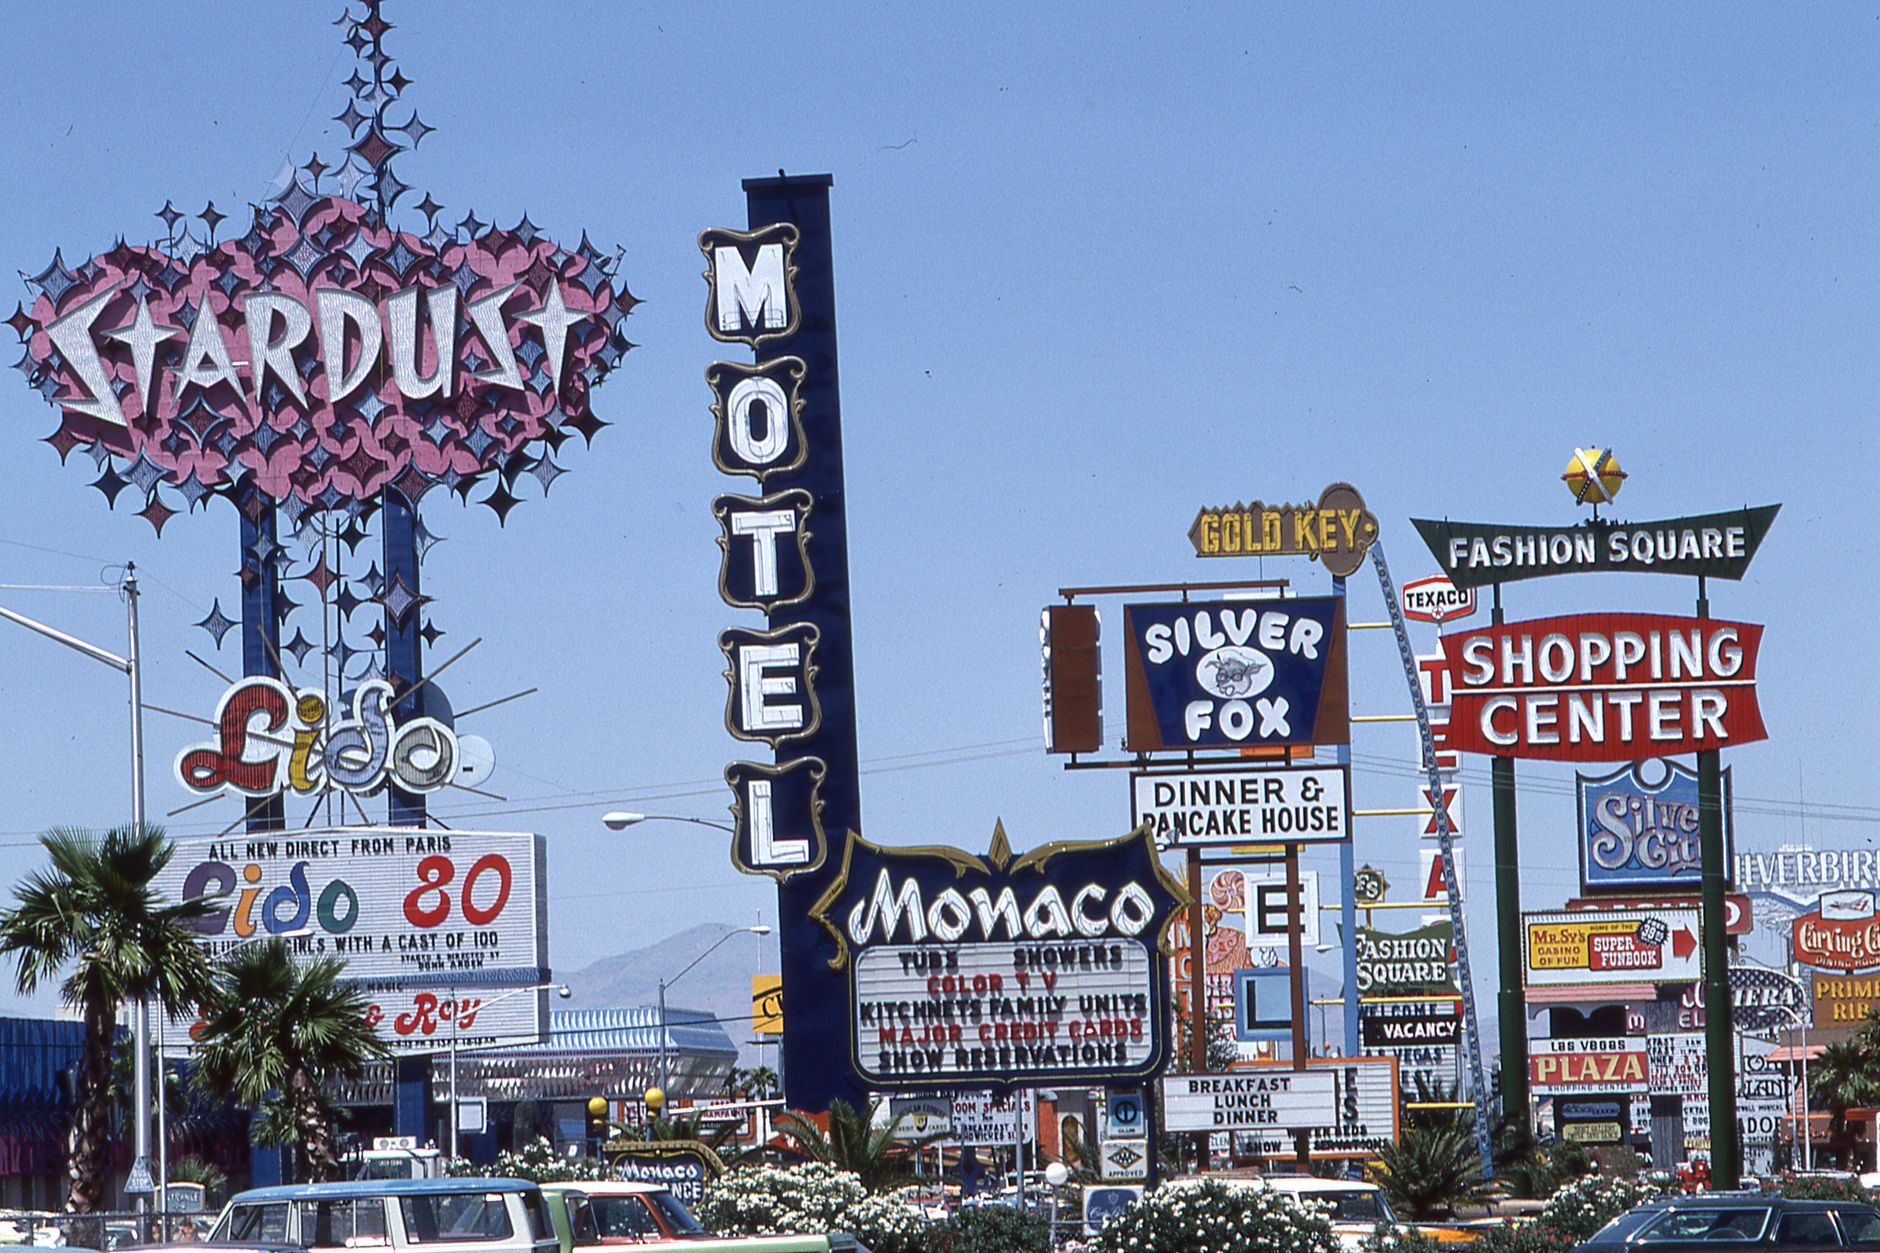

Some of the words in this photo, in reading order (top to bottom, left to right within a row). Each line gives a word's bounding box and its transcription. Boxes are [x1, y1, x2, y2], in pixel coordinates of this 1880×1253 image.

[44, 276, 597, 427] STARDUST
[1201, 511, 1282, 554] GOLD
[1295, 508, 1361, 552] KEY
[714, 244, 811, 866] MOTEL
[1449, 532, 1597, 568] FASHION
[1608, 527, 1747, 563] SQUARE
[1406, 585, 1469, 609] TEXACO
[1144, 608, 1325, 664] SILVER
[1462, 627, 1744, 686] SHOPPING
[1184, 696, 1291, 742] FOX
[1479, 689, 1729, 746] CENTER
[177, 676, 459, 796] Lido
[1154, 778, 1285, 807] DINNER
[1300, 776, 1325, 801] &
[1143, 809, 1252, 840] PANCAKE
[1262, 805, 1339, 834] HOUSE
[1591, 791, 1700, 872] Silve
[208, 843, 238, 861] ALL
[246, 842, 278, 859] NEW
[286, 840, 340, 858] DIRECT
[351, 838, 394, 856] FROM
[406, 836, 451, 854] PARIS
[1635, 822, 1701, 877] Cit
[1734, 850, 1880, 887] ILVERBIR
[181, 860, 360, 938] Lido
[402, 853, 512, 929] 80
[848, 866, 1155, 946] Monaco
[335, 935, 372, 952] WITH
[382, 935, 392, 951] A
[399, 933, 438, 950] CAST
[446, 932, 465, 948] OF
[474, 930, 498, 947] 100
[1537, 946, 1581, 955] CASINO
[1593, 936, 1635, 951] SUPER
[898, 950, 959, 972] TUBS
[1013, 945, 1123, 968] SHOWERS
[1538, 957, 1552, 966] OF
[1556, 956, 1579, 965] FUN
[1600, 951, 1657, 967] FUNBOOK
[1815, 956, 1852, 967] DINING
[927, 973, 1003, 995] COLOR
[1016, 972, 1030, 992] T
[1041, 971, 1058, 991] V
[1356, 961, 1447, 991] SQUARE
[860, 999, 982, 1023] KITCHNETS
[989, 996, 1067, 1019] FAMILY
[1080, 994, 1147, 1015] UNITS
[1735, 986, 1795, 1008] IERA
[394, 992, 480, 1036] Roy
[1832, 1003, 1870, 1022] RIB
[878, 1024, 963, 1047] MAJOR
[979, 1021, 1059, 1042] CREDIT
[1068, 1018, 1143, 1039] CARDS
[1383, 1021, 1458, 1039] VACANCY
[878, 1049, 945, 1072] SHOW
[955, 1043, 1127, 1069] RESERVATIONS
[1537, 1054, 1644, 1083] PLAZA
[1189, 1077, 1291, 1094] BREAKFAST
[1548, 1085, 1592, 1093] SHOPPING
[1214, 1095, 1271, 1109] LUNCH
[1213, 1110, 1278, 1125] DINNER
[1108, 1170, 1144, 1178] APPROVED
